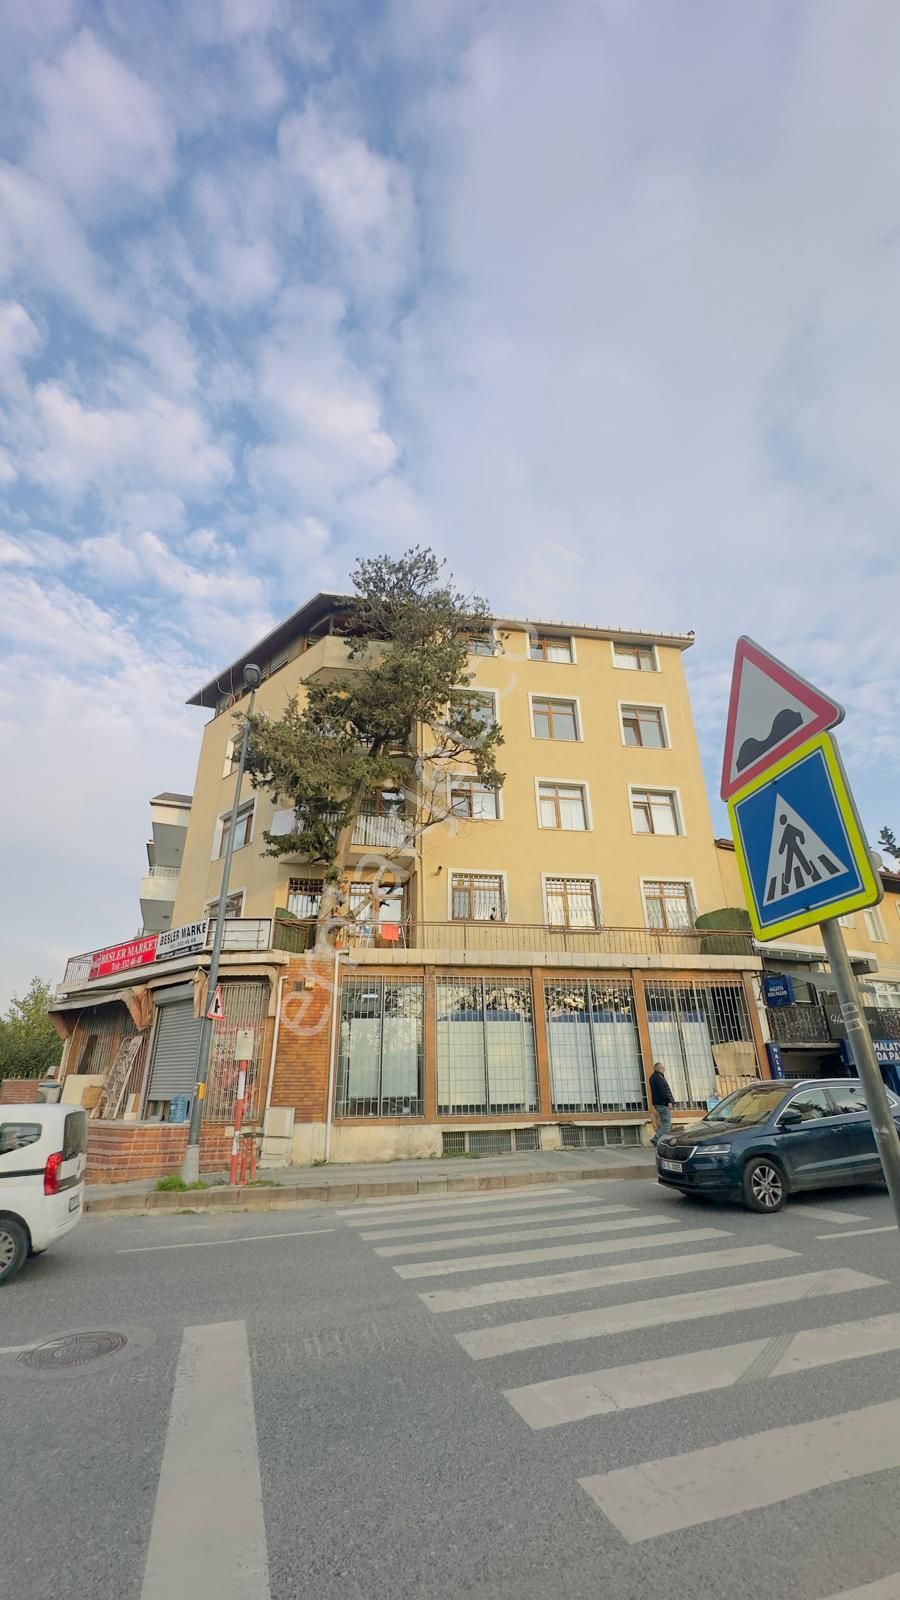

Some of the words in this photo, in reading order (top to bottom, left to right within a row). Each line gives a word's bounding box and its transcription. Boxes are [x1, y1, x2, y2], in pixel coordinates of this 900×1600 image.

[101, 948, 127, 963] BESLER
[772, 1047, 782, 1078] MALAT
[888, 1052, 900, 1061] PA
